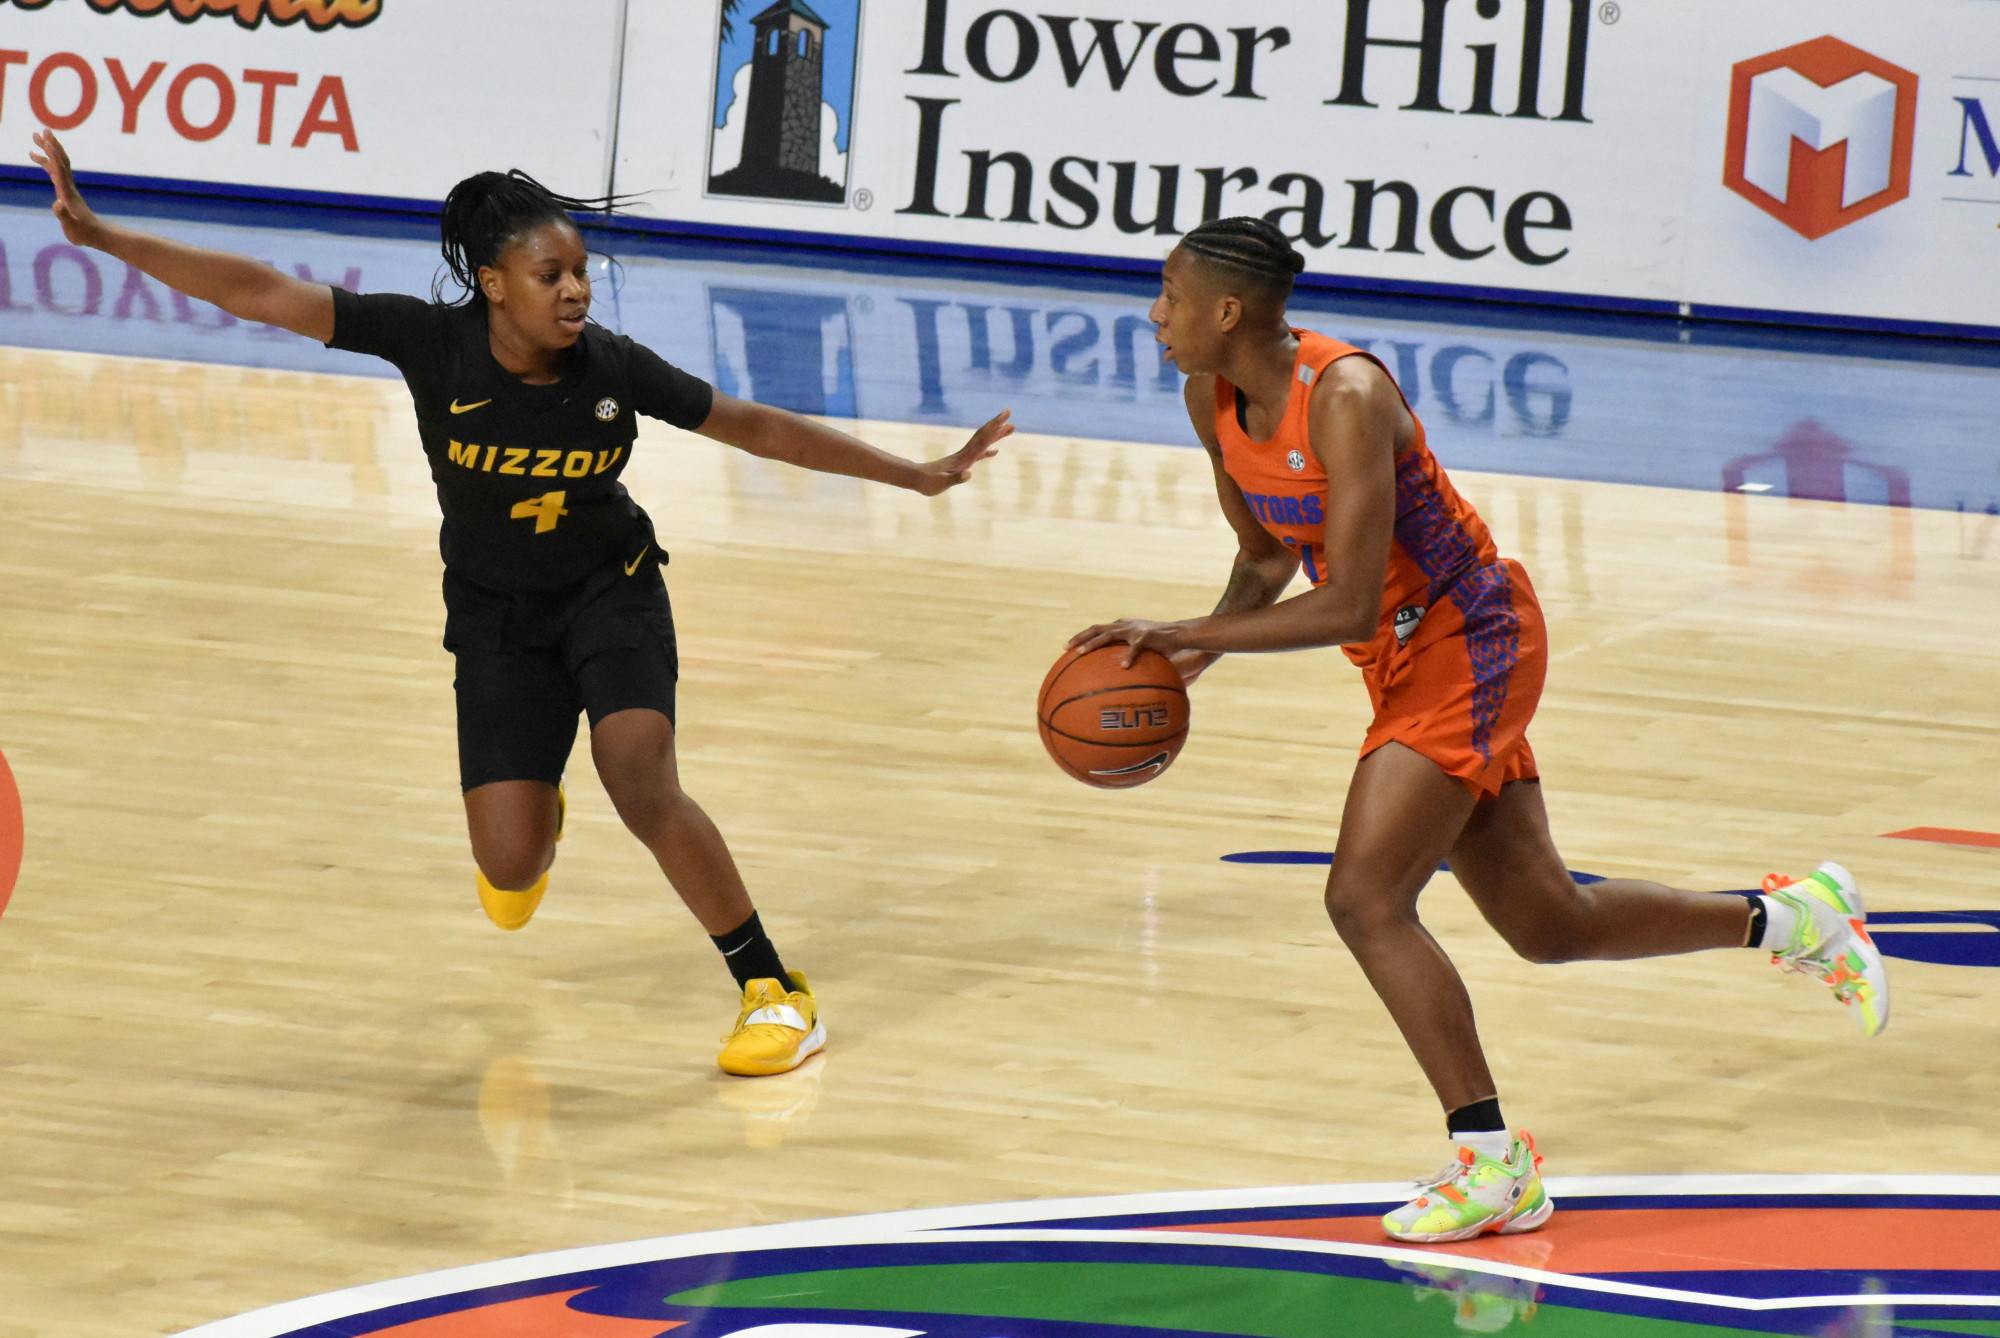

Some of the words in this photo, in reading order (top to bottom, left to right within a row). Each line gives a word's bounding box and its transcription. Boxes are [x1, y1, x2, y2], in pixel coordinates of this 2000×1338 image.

[1322, 0, 1594, 124] Hill
[894, 96, 1573, 266] Insurance
[448, 438, 623, 479] MIZZOU
[510, 490, 568, 534] 4
